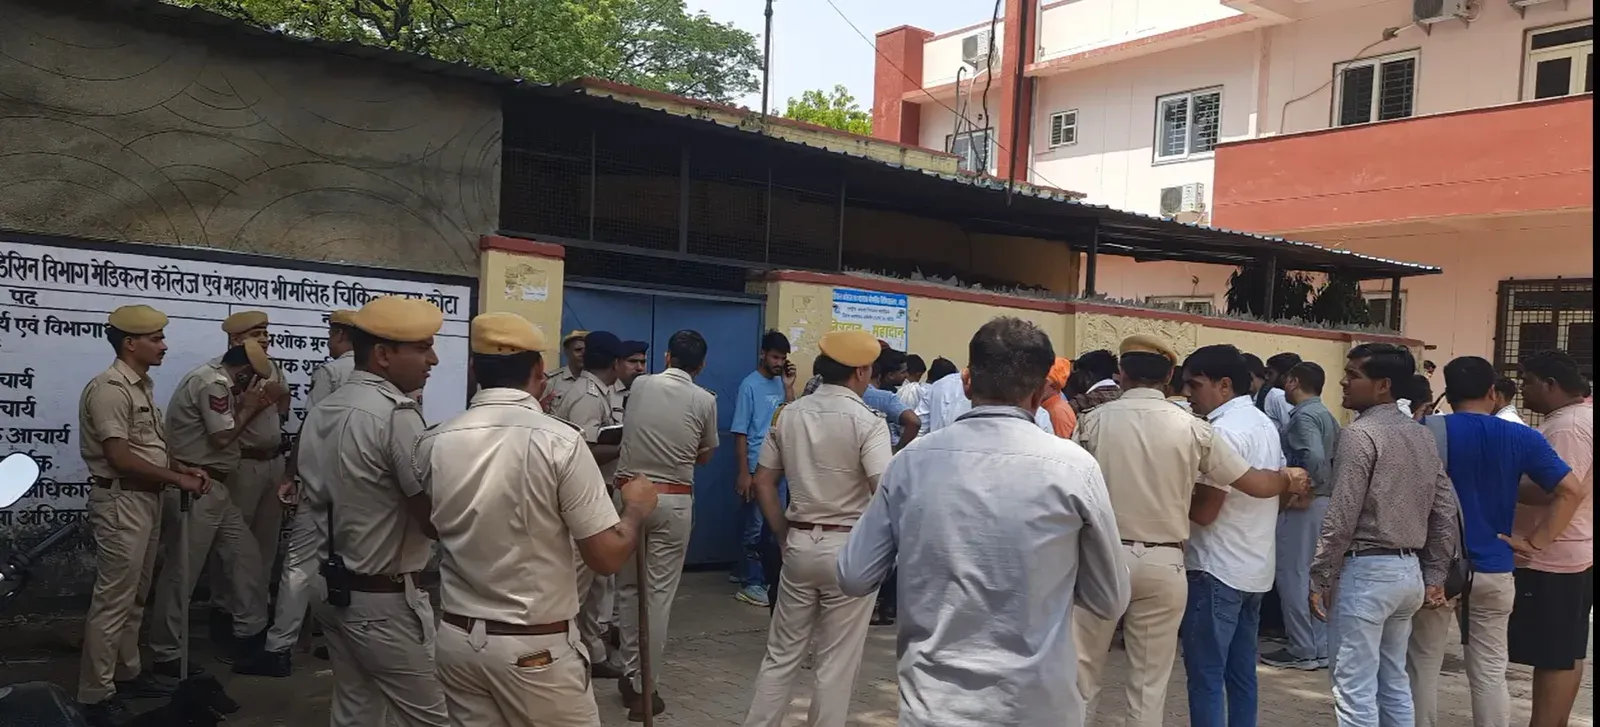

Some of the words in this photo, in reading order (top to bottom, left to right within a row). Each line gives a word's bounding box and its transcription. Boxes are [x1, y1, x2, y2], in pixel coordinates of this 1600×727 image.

[42, 254, 89, 285] विभाग
[91, 258, 149, 291] मेडिकल
[151, 264, 199, 296] कॉलेज
[202, 270, 222, 297] एवं
[224, 275, 268, 300] महाराव
[270, 275, 330, 307] भीमसिंह
[425, 289, 459, 314] कोटा
[9, 289, 38, 306] पद
[14, 315, 40, 338] एवं
[7, 424, 71, 444] आचार्य
